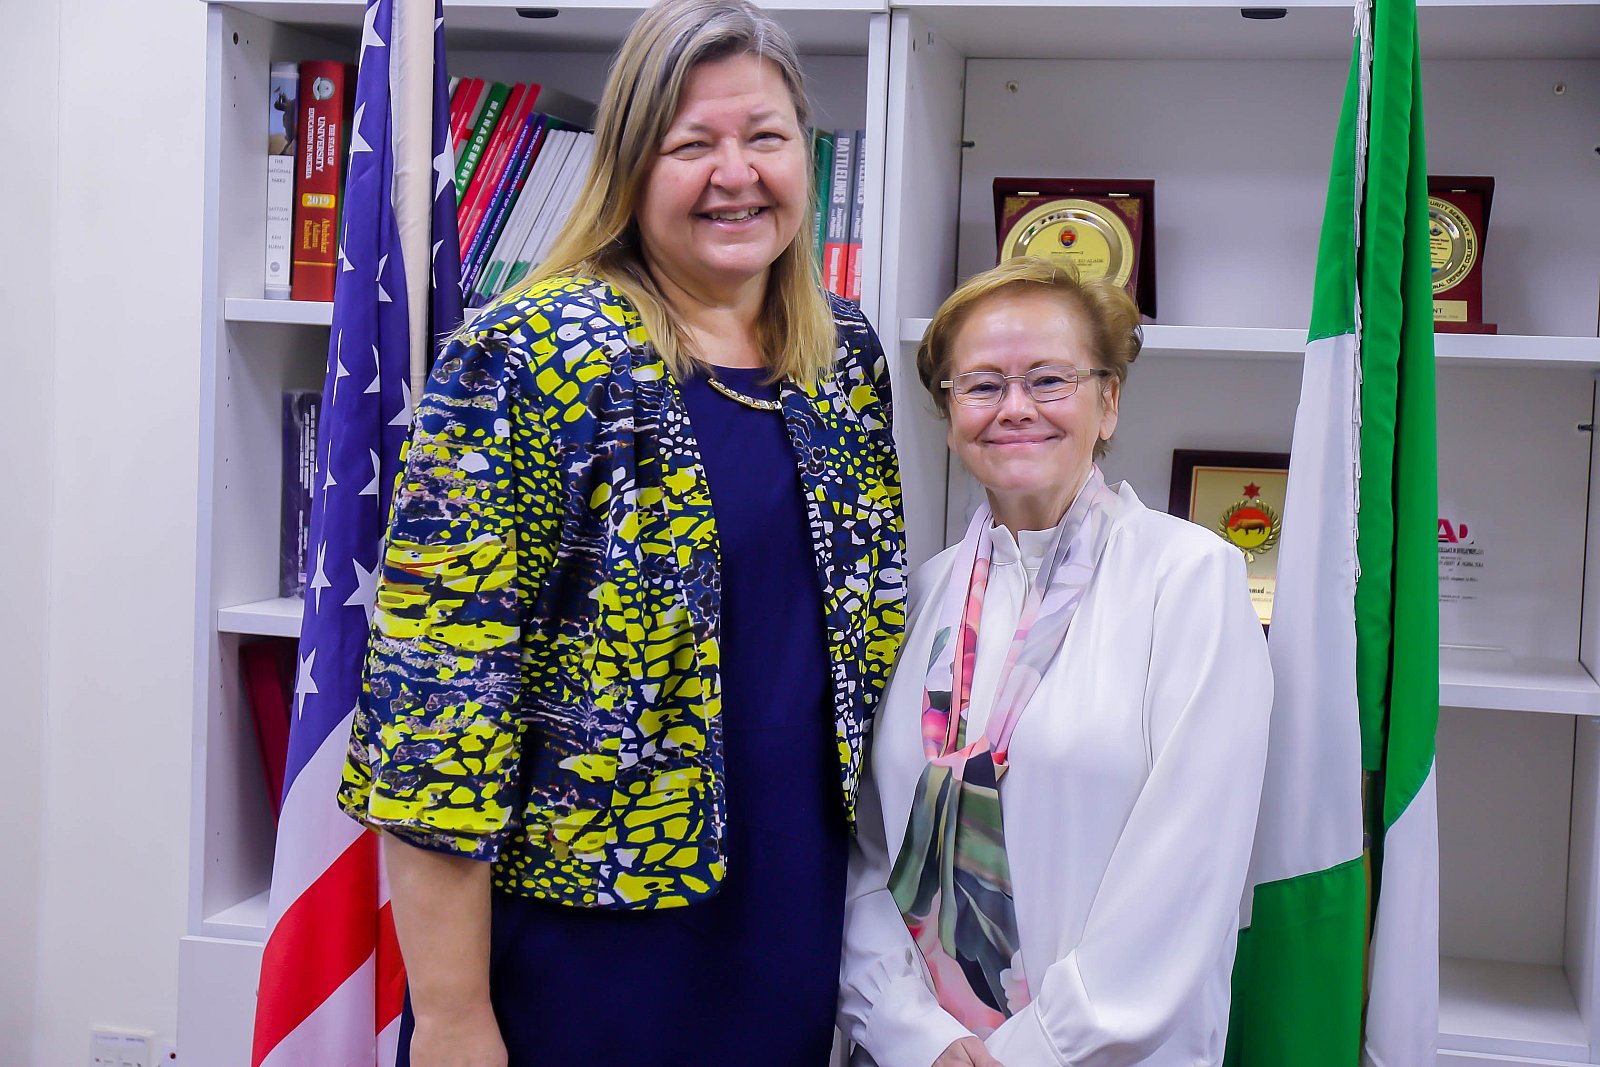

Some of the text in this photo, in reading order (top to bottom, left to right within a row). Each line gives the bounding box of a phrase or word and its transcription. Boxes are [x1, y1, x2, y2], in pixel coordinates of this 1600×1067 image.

[307, 107, 315, 144] EDUCATION
[328, 123, 336, 136] THE
[307, 144, 313, 152] IN
[315, 116, 326, 172] UNIVERSITY
[458, 100, 498, 186] MANAGEMENT
[512, 124, 528, 159] AMERICAN
[525, 125, 542, 159] AMERICAN
[327, 156, 334, 166] OF
[833, 138, 850, 203] BATTLELINES
[495, 159, 513, 197] UNIVERSITY
[508, 160, 527, 198] UNIVERSITY
[306, 195, 330, 205] 2019
[491, 197, 496, 207] OF
[504, 198, 510, 207] OF
[1429, 200, 1449, 210] URITY
[478, 207, 492, 233] NIGERIA
[491, 208, 505, 234] NIGERIA
[465, 234, 480, 263] CATALOG
[477, 234, 493, 263] CATALOG
[1446, 264, 1467, 284] DEFENCE
